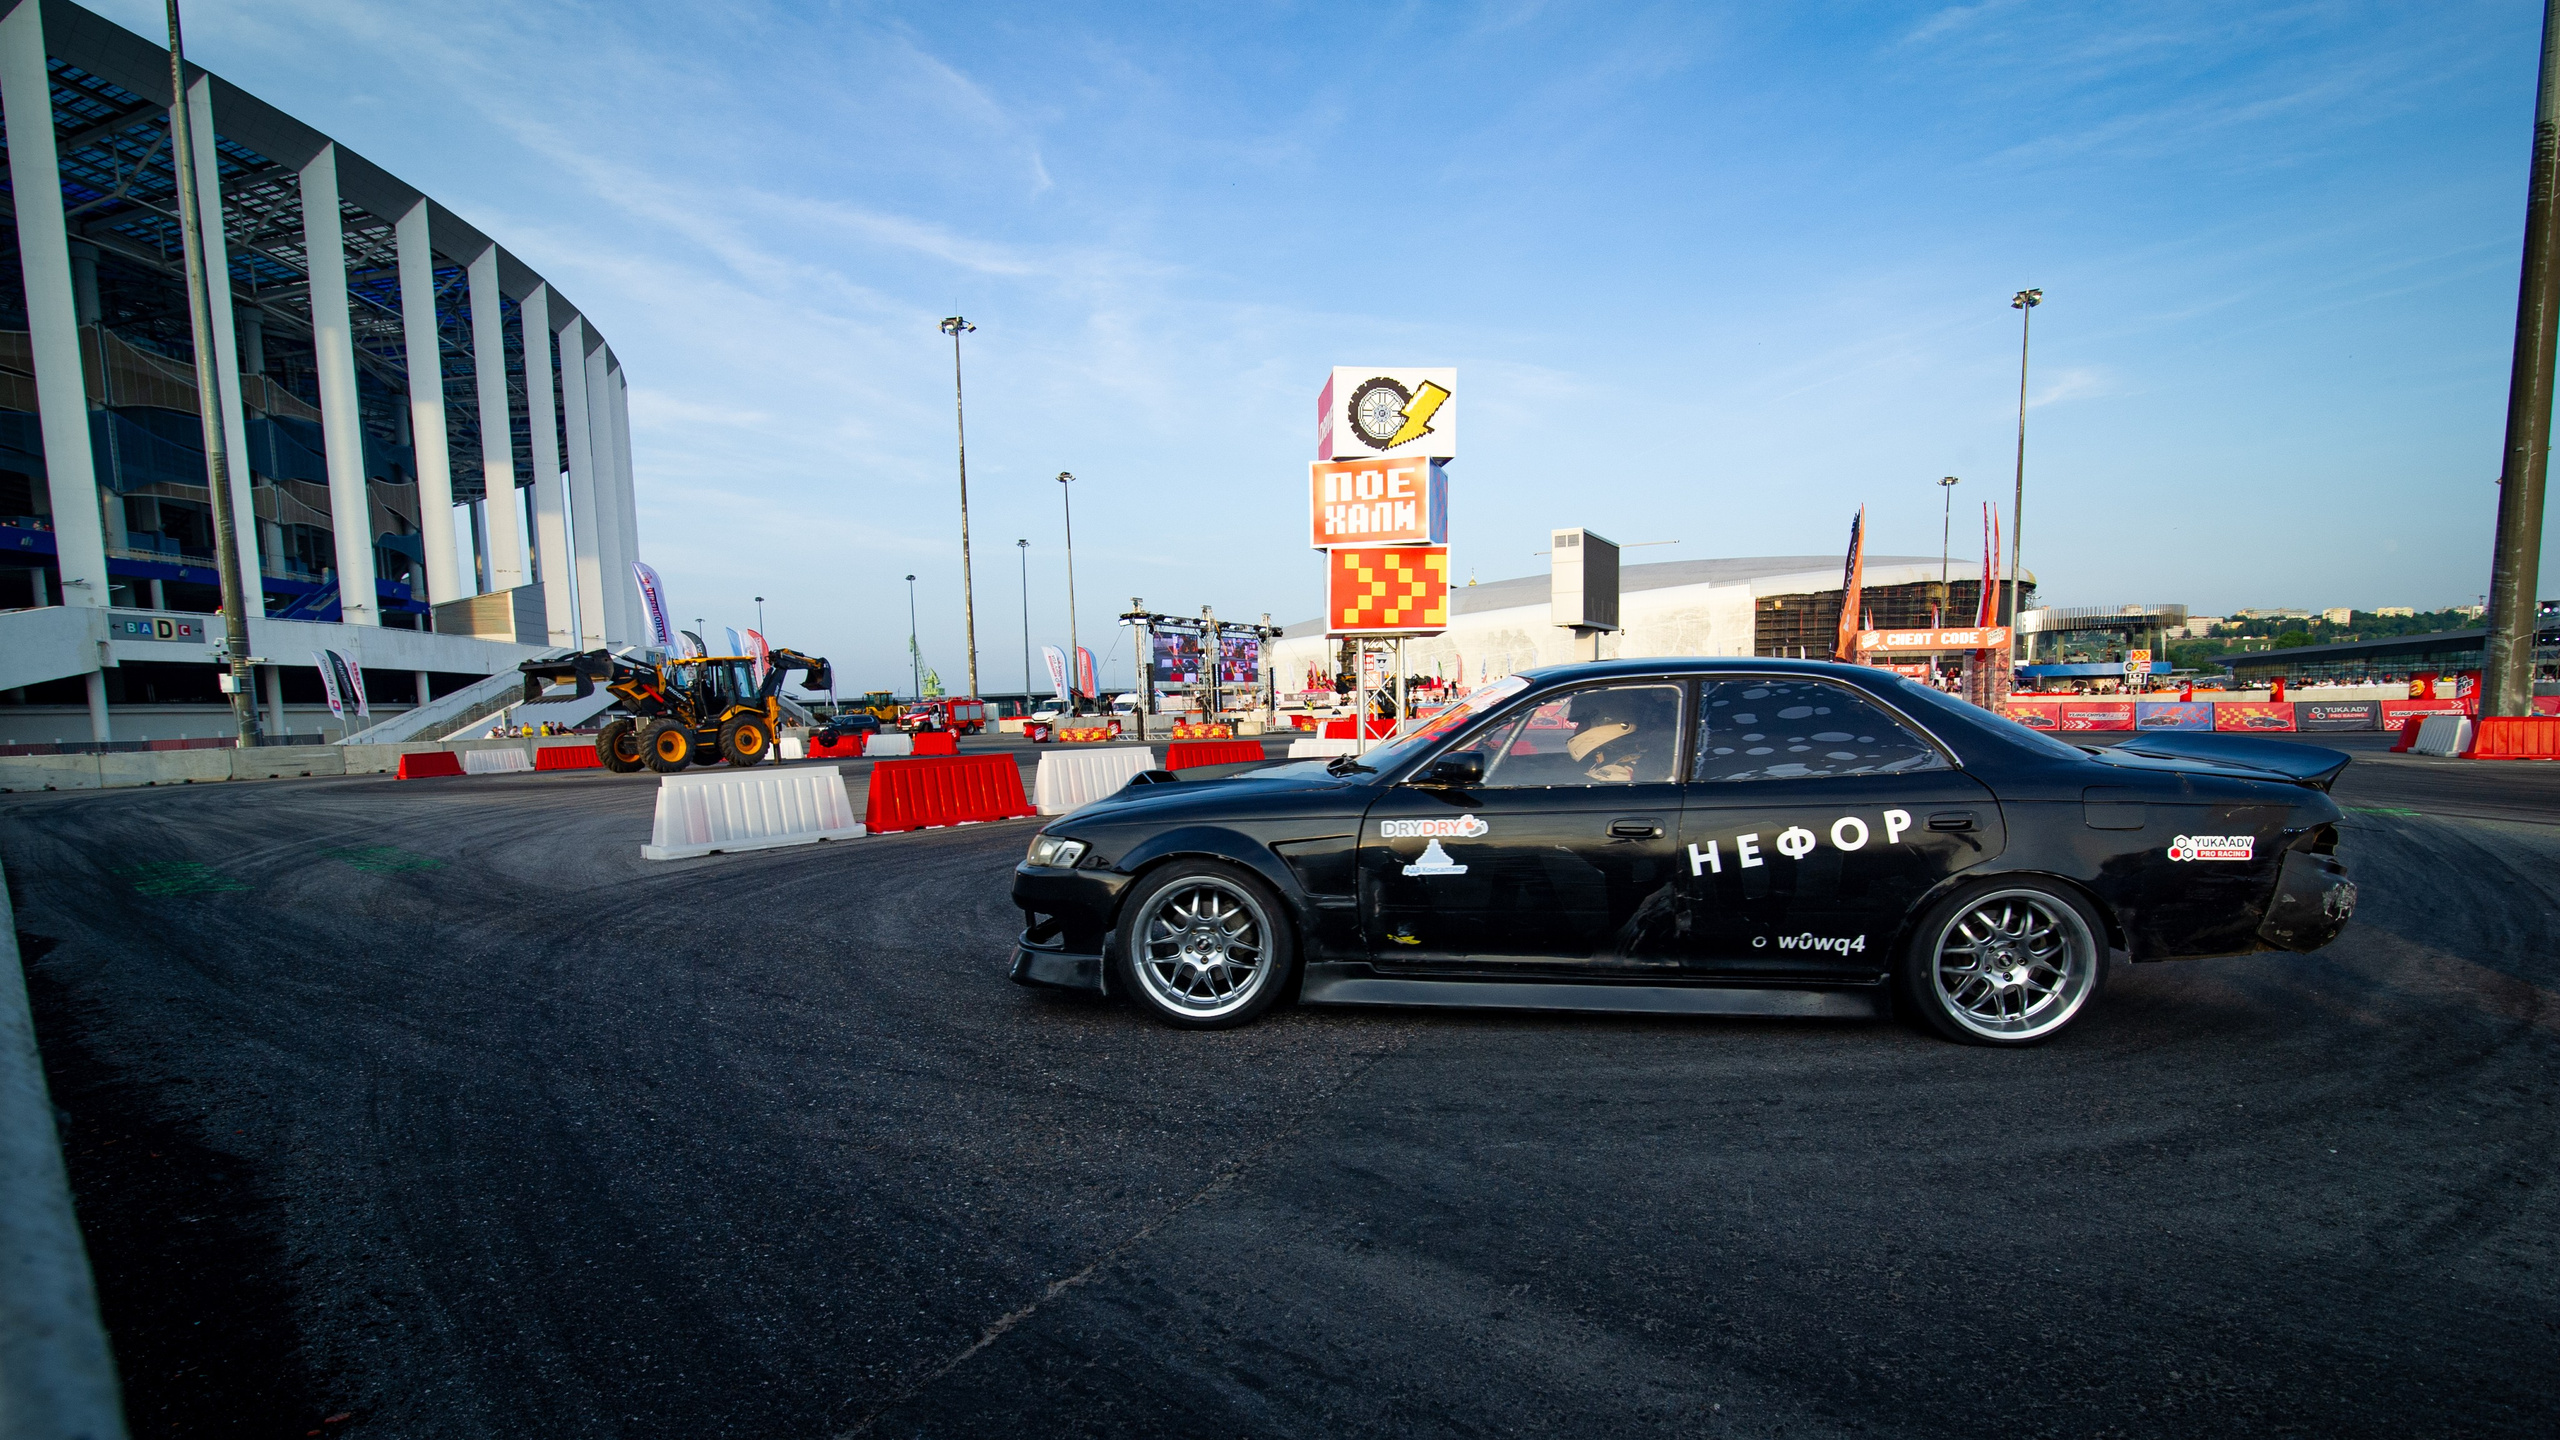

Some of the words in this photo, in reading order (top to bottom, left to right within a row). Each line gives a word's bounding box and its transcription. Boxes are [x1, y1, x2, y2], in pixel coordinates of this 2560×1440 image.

[1324, 467, 1416, 502] ПОЕ
[1324, 500, 1416, 535] ХАЛИ
[127, 622, 137, 633] B
[141, 624, 151, 634] A
[157, 620, 173, 638] D
[180, 625, 189, 635] C
[1887, 632, 1934, 646] CHEAT
[1940, 631, 1980, 645] CODE
[1384, 822, 1460, 835] DRYDRY
[1688, 808, 1912, 877] НЕФОР
[2195, 838, 2226, 847] YUKA
[2228, 838, 2252, 847] ADV
